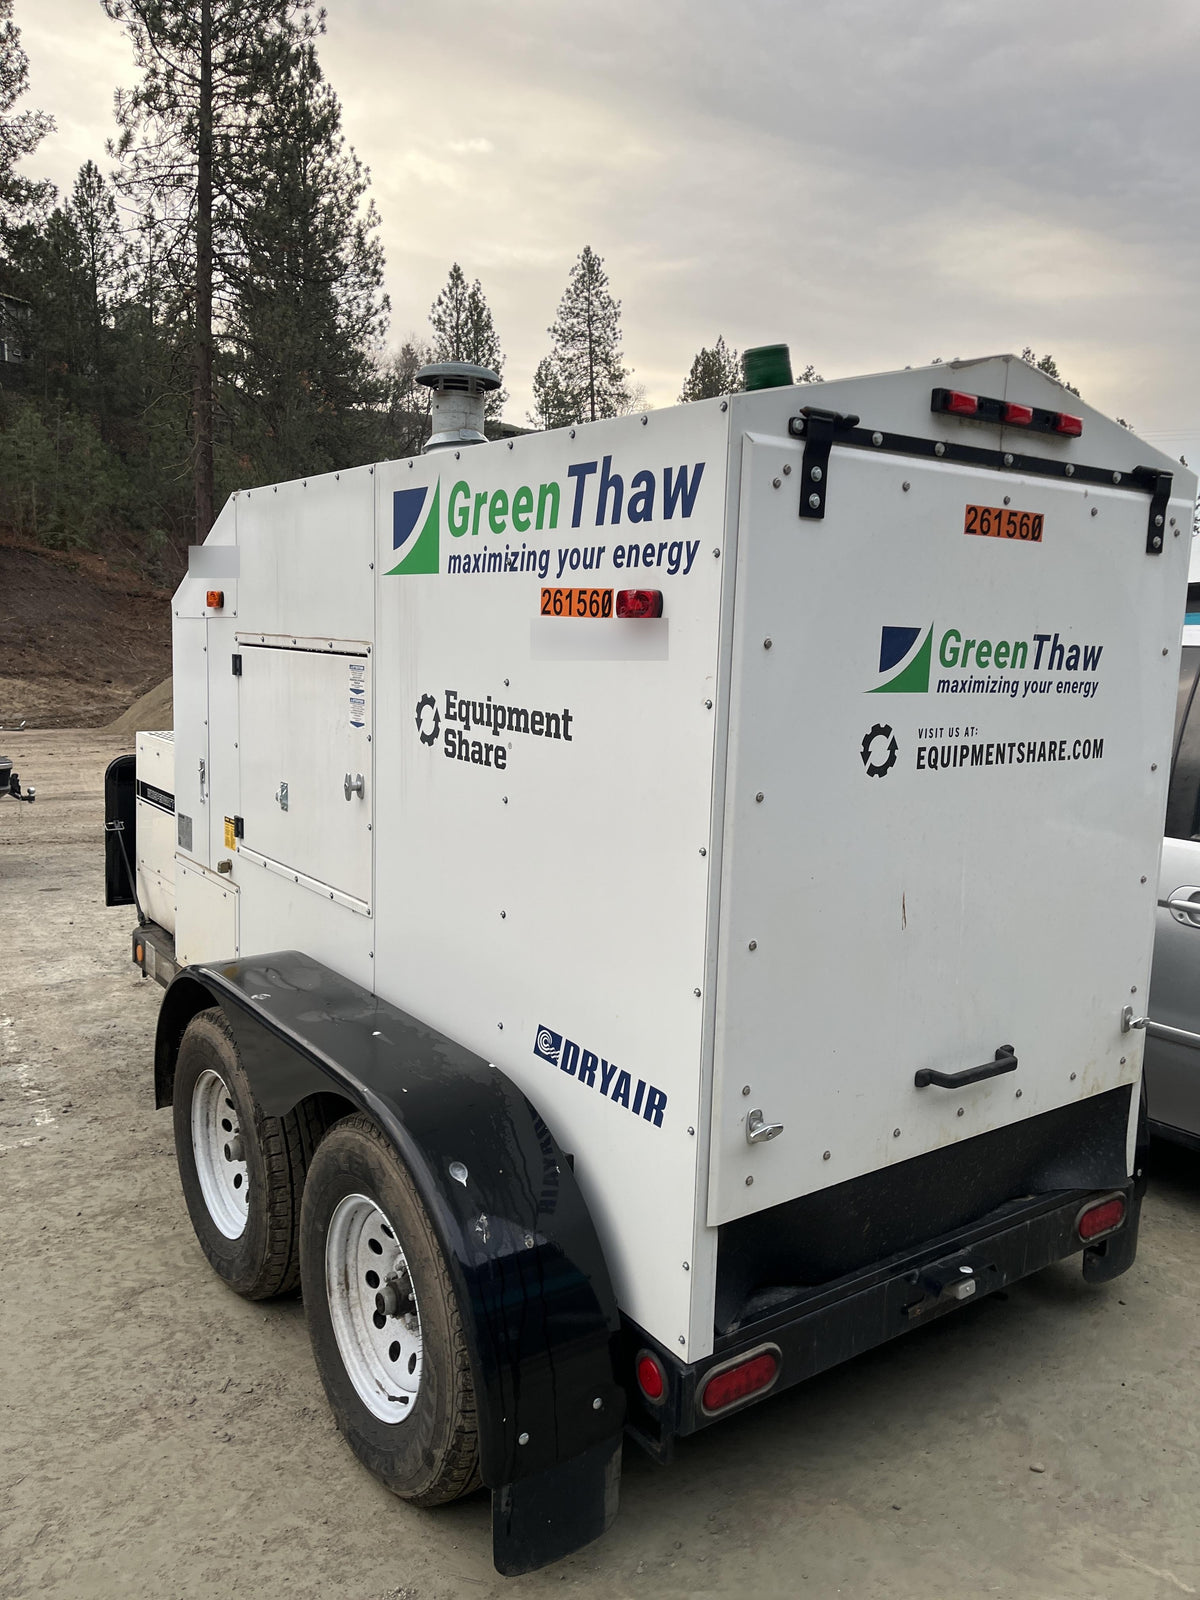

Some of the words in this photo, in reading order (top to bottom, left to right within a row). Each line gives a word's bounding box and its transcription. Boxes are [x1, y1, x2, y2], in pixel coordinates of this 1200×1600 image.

[965, 507, 1042, 541] 261560
[448, 543, 550, 579] maximizing
[556, 546, 605, 579] your
[613, 540, 700, 575] energy
[542, 590, 612, 617] 261560
[937, 675, 1019, 697] maximizing
[1022, 681, 1053, 699] your
[1056, 681, 1099, 699] energy
[445, 690, 573, 741] Equipment
[918, 728, 944, 739] VISIT
[948, 727, 960, 738] US
[964, 727, 978, 737] AT:
[916, 738, 1104, 770] EQUIPMENTSHARE.COM
[560, 1039, 668, 1128] DRYAIR
